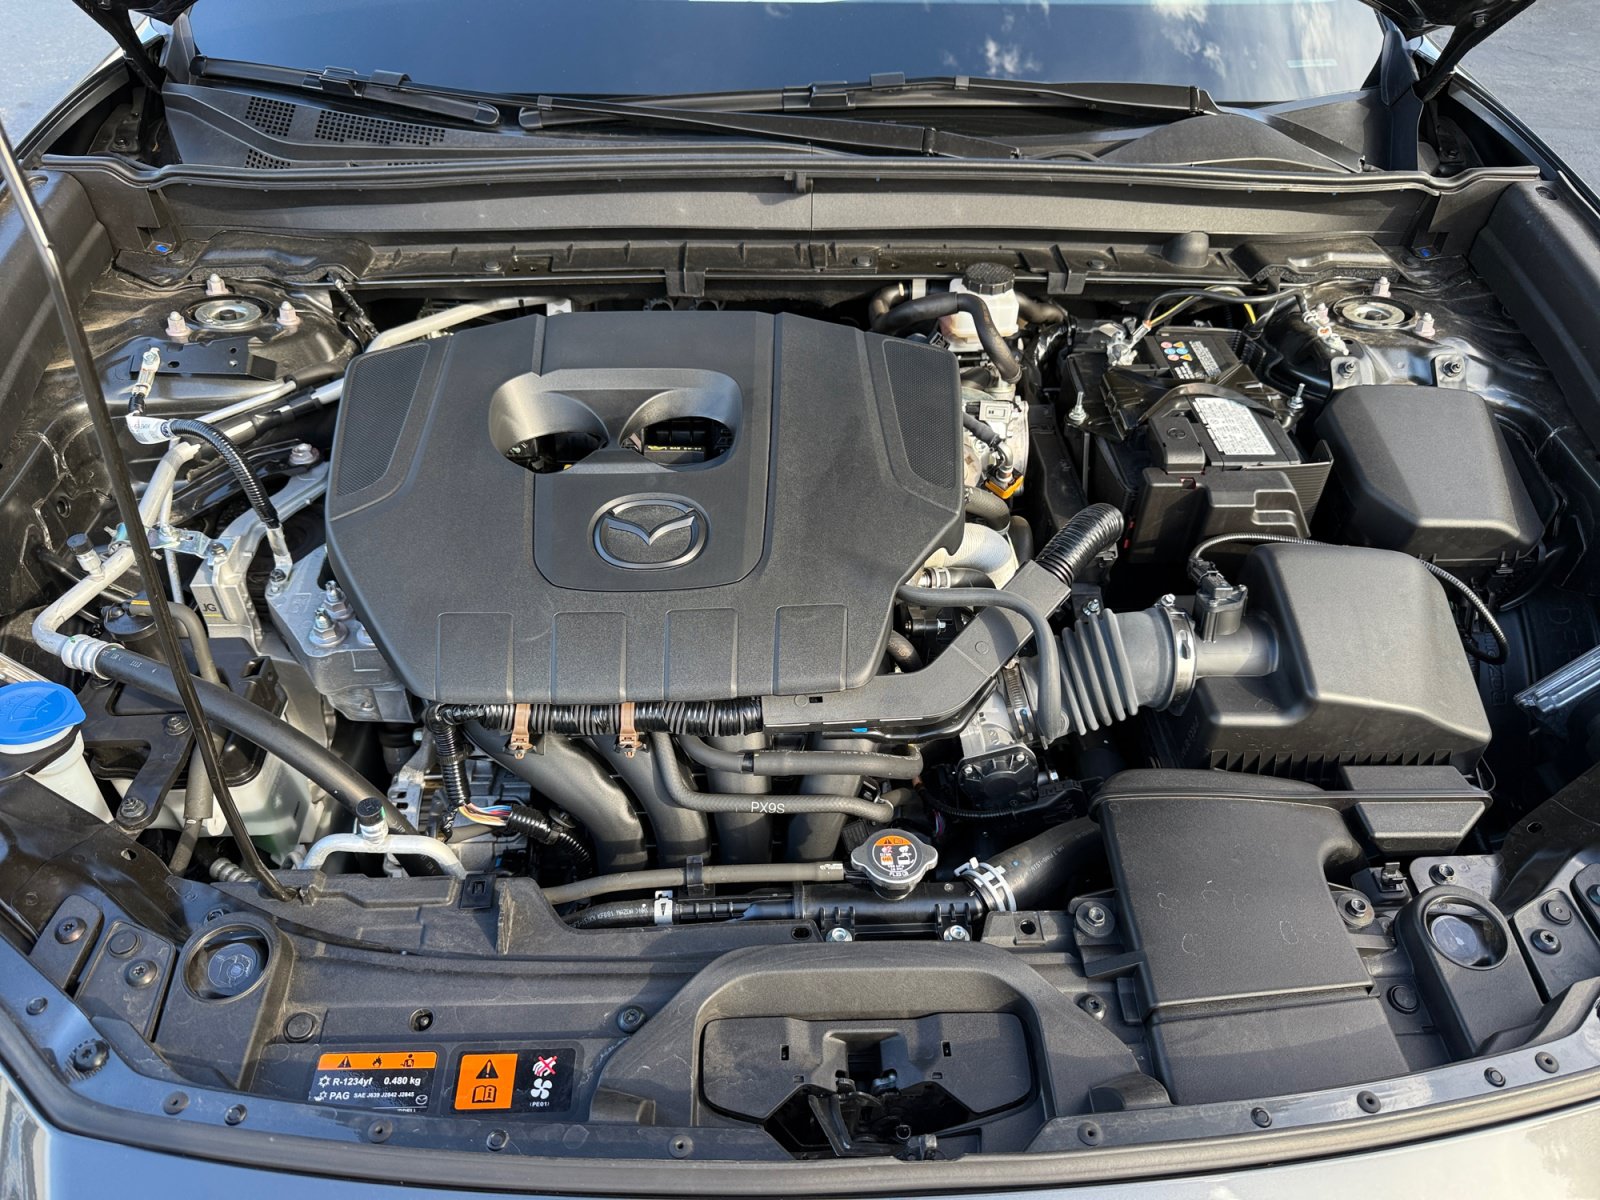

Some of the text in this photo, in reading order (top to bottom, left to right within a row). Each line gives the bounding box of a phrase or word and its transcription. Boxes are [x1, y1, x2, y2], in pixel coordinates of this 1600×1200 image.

[751, 801, 785, 814] PX9S
[333, 1077, 421, 1087] R-1234yf 0.480 kg
[329, 1091, 350, 1100] PAG
